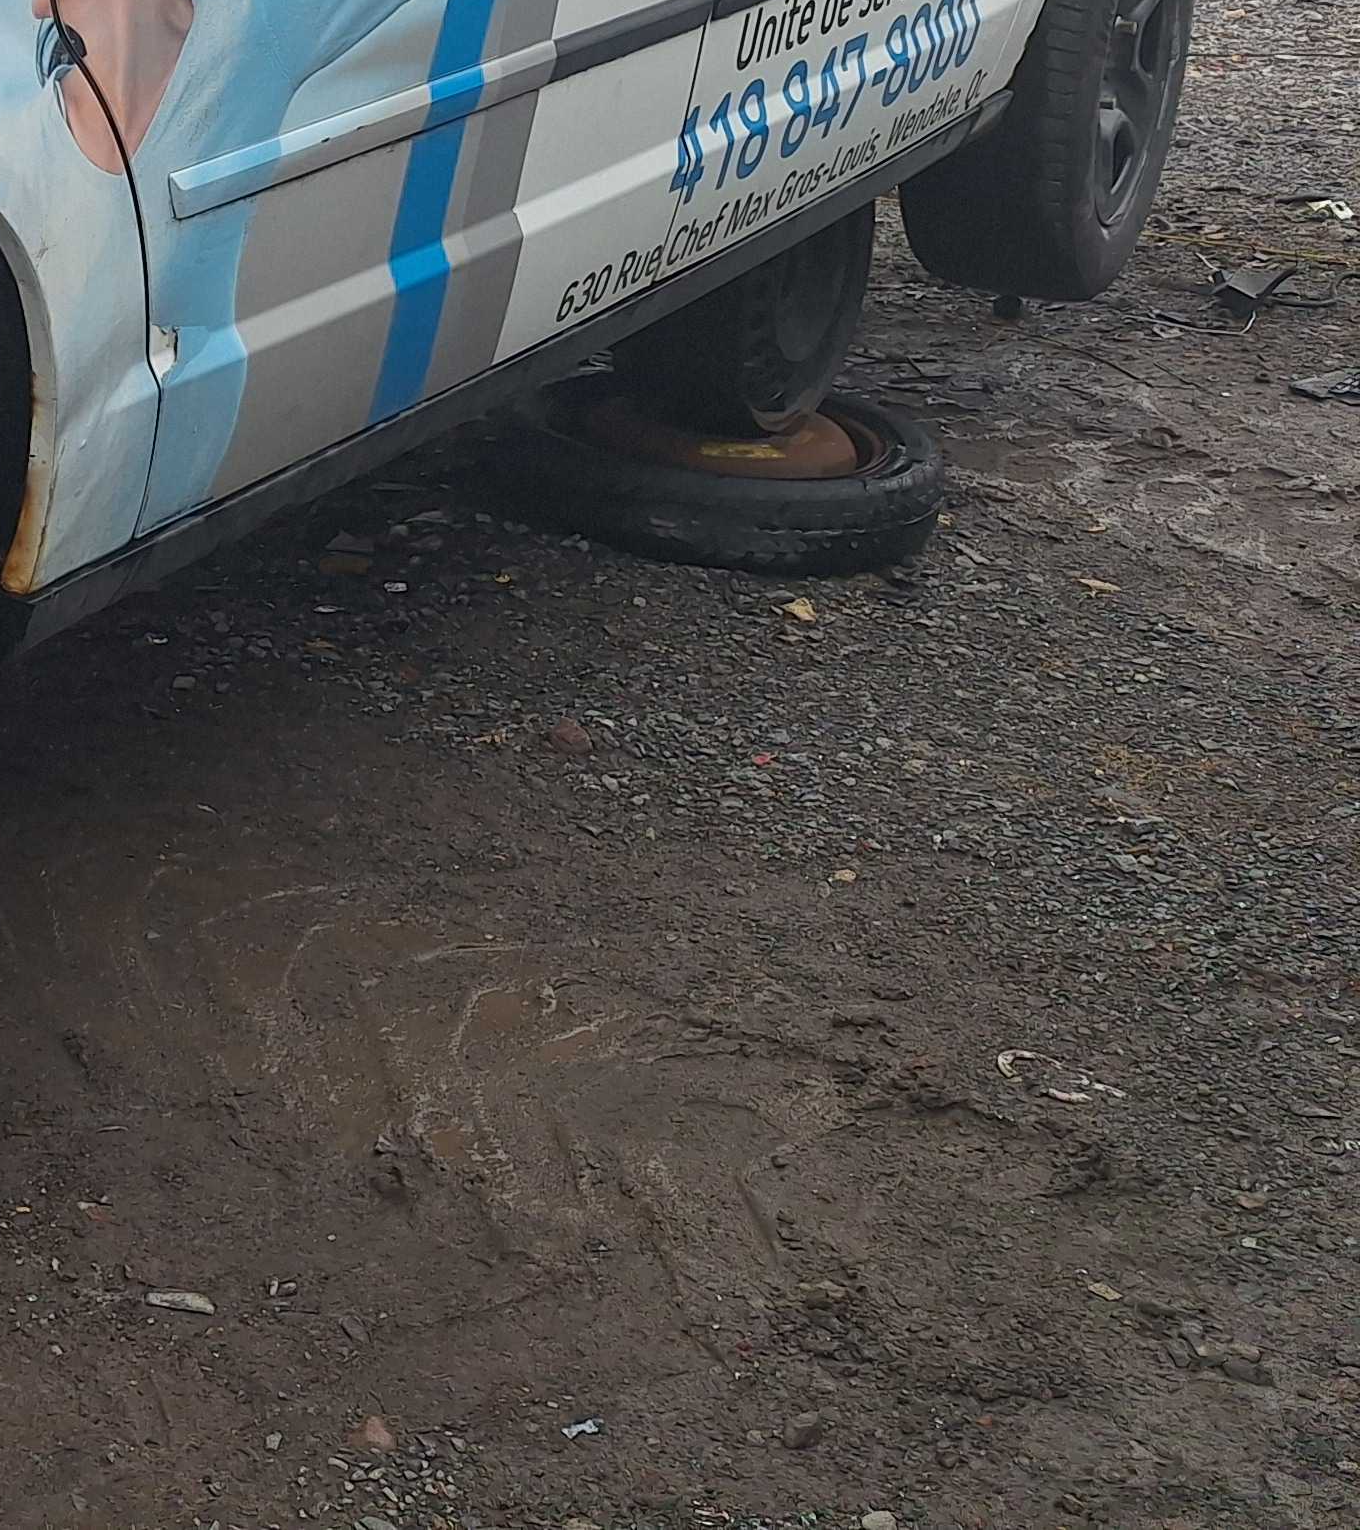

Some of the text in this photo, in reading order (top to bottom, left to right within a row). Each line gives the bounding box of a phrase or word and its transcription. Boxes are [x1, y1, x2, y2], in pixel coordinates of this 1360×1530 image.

[668, 77, 770, 205] 418
[555, 263, 614, 322] 630
[612, 244, 664, 295] Rue
[666, 201, 730, 267] Chef
[723, 188, 777, 239] Max
[776, 128, 881, 212] Gros-Louis,
